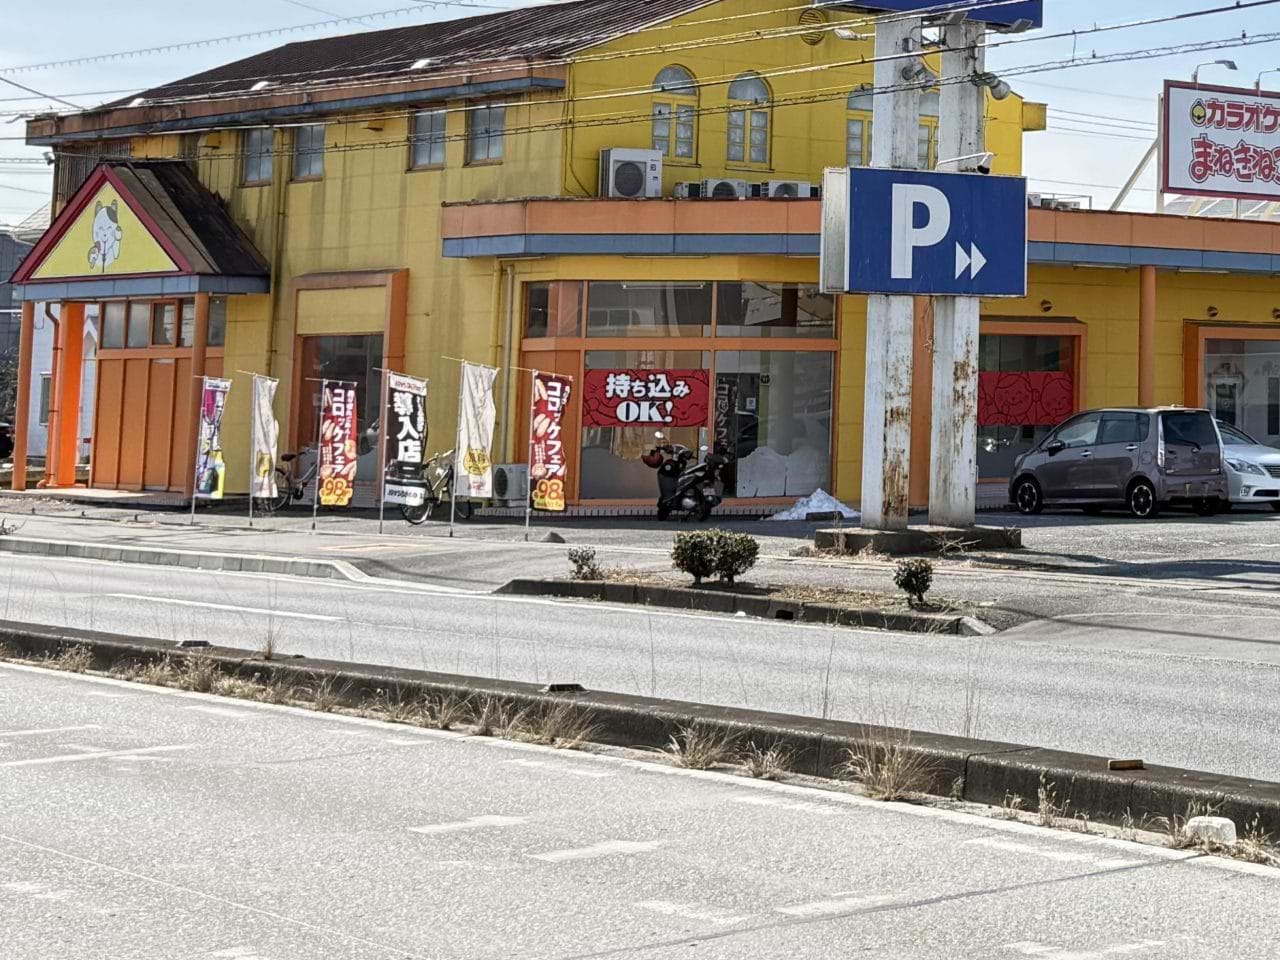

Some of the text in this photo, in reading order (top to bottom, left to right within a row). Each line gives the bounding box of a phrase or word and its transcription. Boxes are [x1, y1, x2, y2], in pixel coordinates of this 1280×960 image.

[890, 183, 951, 279] P
[605, 373, 691, 399] 持ち込み
[616, 400, 674, 423] OK!
[331, 388, 346, 474] コロッケフェア
[544, 381, 562, 478] コロッケフェア
